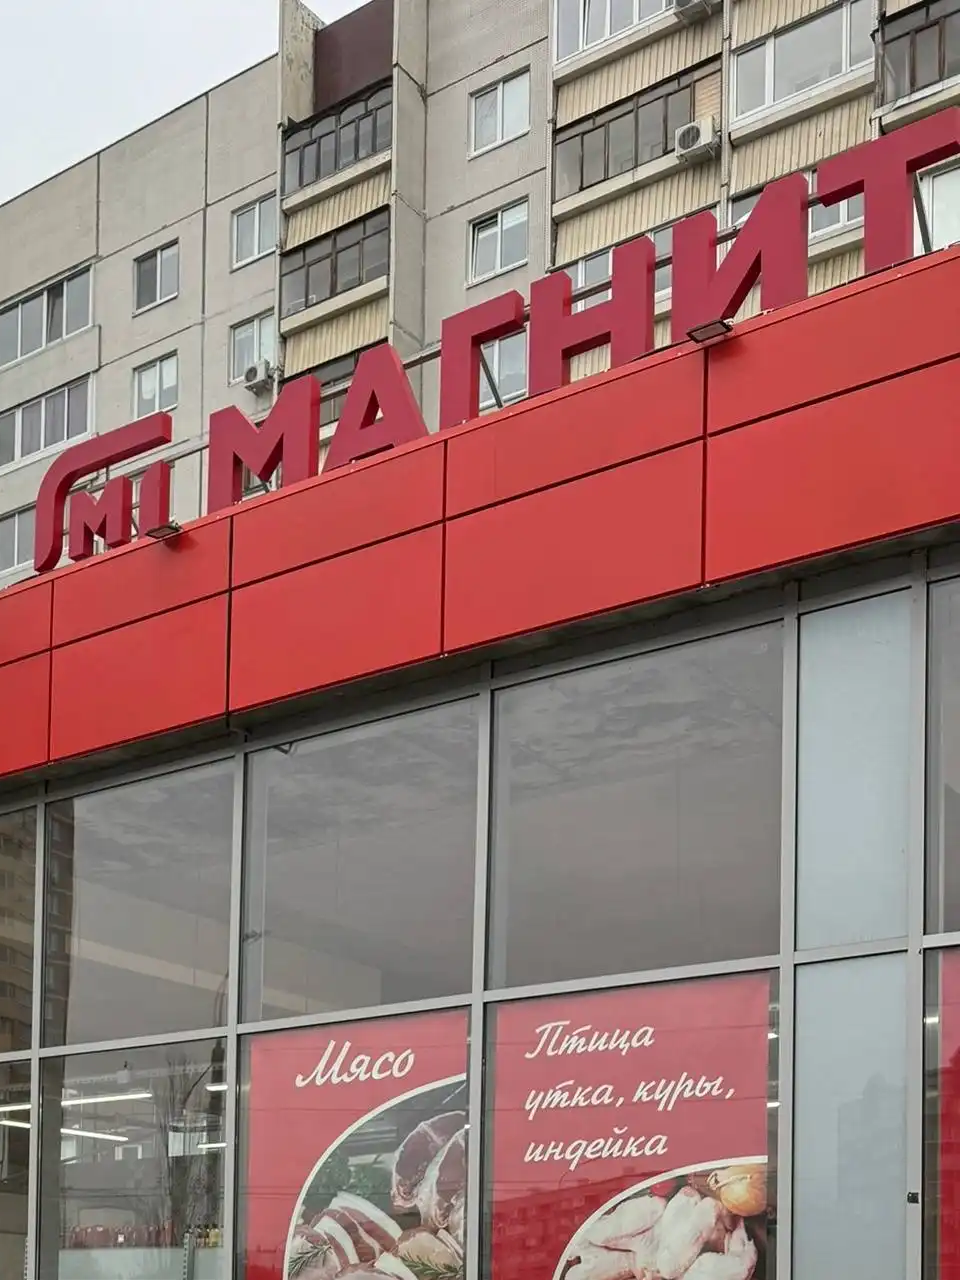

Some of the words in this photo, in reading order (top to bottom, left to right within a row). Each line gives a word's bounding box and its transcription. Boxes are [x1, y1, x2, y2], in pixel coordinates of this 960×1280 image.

[206, 107, 960, 516] МАГНИТ
[295, 1039, 415, 1089] Мясо
[524, 1019, 655, 1060] Птица
[524, 1081, 625, 1121] утка,
[632, 1071, 736, 1116] куры,
[524, 1125, 669, 1171] индейка
